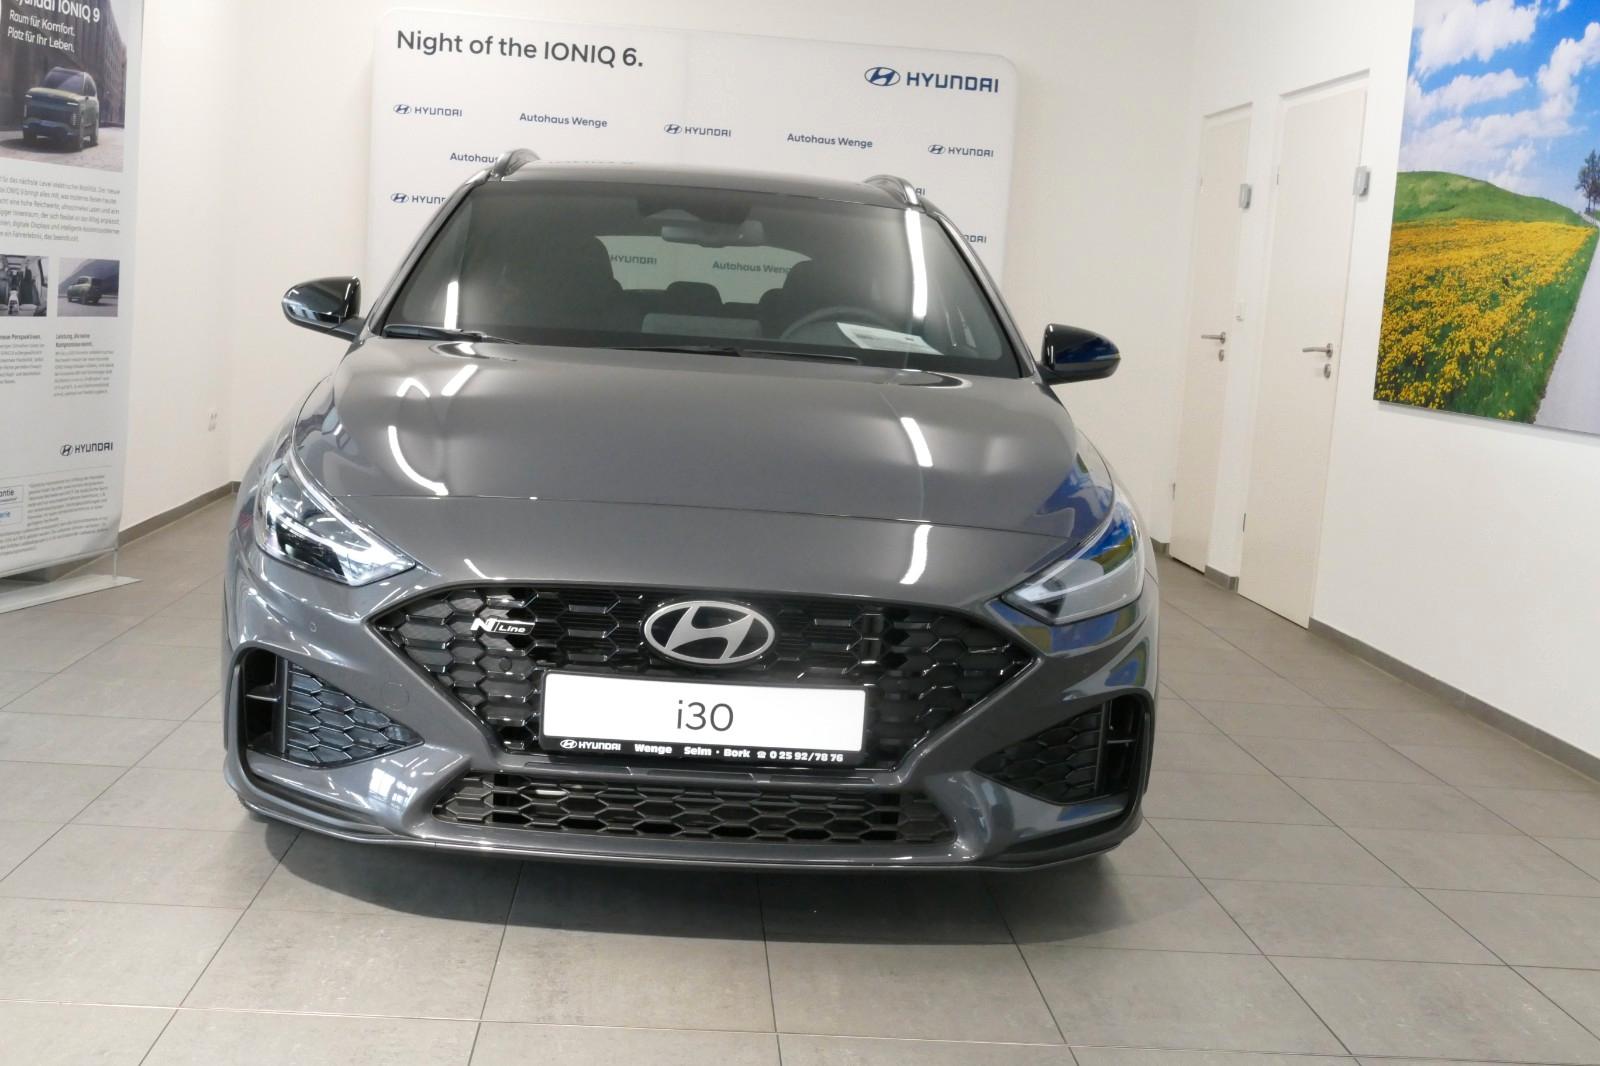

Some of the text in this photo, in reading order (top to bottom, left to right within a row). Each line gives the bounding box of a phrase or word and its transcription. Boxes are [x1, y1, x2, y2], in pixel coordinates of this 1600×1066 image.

[58, 0, 91, 23] IONIQ
[93, 7, 101, 23] 9
[9, 9, 76, 36] Raum für Komfort.
[7, 26, 75, 53] Platz für Ihr Leben.
[397, 30, 644, 68] Night of the IONIQ 6.
[906, 71, 1000, 94] HYUNDAI
[414, 105, 463, 117] HYUNDAI
[519, 112, 608, 129] Autohaus Wenge
[684, 125, 732, 138] HYUNDAI
[787, 133, 873, 150] Autohaus Wenge
[947, 146, 995, 158] HYUNDAI
[411, 195, 446, 204] HYUN
[712, 260, 761, 273] Autohaus
[75, 442, 113, 454] HYUNDAI
[498, 625, 526, 633] Line
[676, 699, 735, 732] i30
[578, 741, 844, 763] HYUNDAI Wenge Selm Bork 0 25 92/78 76
